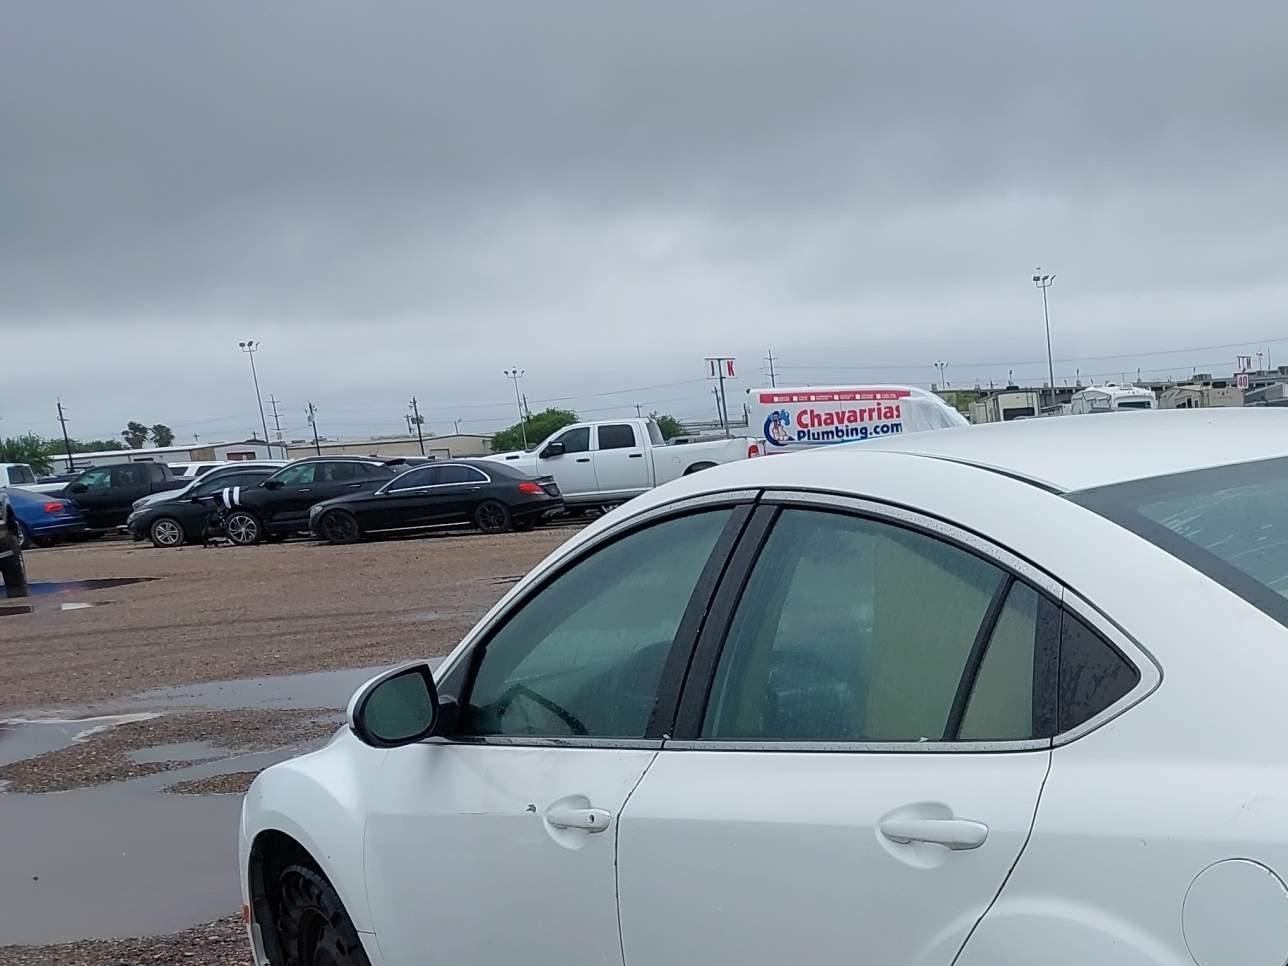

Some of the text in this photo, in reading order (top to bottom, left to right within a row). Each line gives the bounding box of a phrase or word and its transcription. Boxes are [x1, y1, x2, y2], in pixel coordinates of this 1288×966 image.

[727, 361, 735, 376] K
[796, 402, 902, 429] Chavarrias
[797, 422, 903, 441] Plumbing.com
